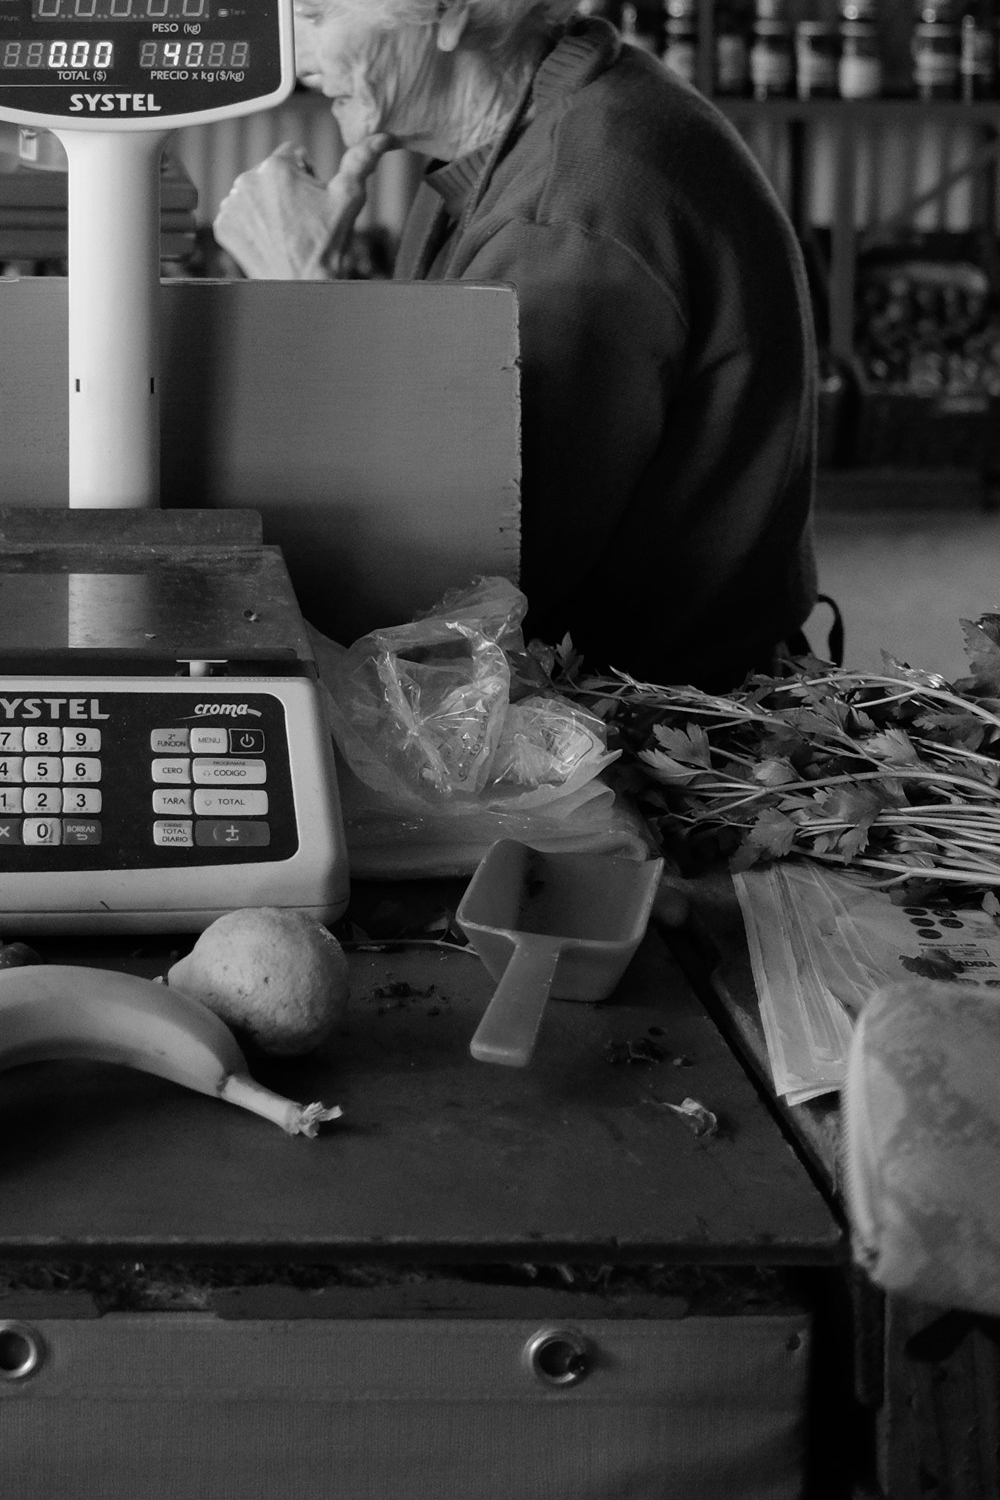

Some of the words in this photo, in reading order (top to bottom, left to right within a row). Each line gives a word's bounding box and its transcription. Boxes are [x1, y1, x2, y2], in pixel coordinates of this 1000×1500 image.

[152, 23, 179, 33] PESO
[183, 23, 201, 35] (kg)
[57, 70, 91, 81] TOTAL
[93, 70, 107, 82] ($)
[150, 70, 189, 81] PRECIO
[191, 72, 199, 80] x
[68, 93, 162, 112] SYSTEL
[191, 703, 262, 718] croma
[0, 731, 12, 746] 7
[37, 731, 49, 746] 8
[75, 731, 87, 747] 9
[37, 762, 49, 777] 5
[75, 762, 87, 777] 6
[162, 766, 183, 774] CERO
[213, 769, 247, 777] CODIGO
[0, 792, 8, 807] 1
[37, 792, 48, 807] 2
[76, 793, 86, 808] 3
[162, 797, 186, 805] TARA
[217, 798, 246, 806] TOTAL
[36, 823, 49, 839] 0
[66, 825, 96, 833] BORRAR
[162, 835, 189, 843] DIARIO
